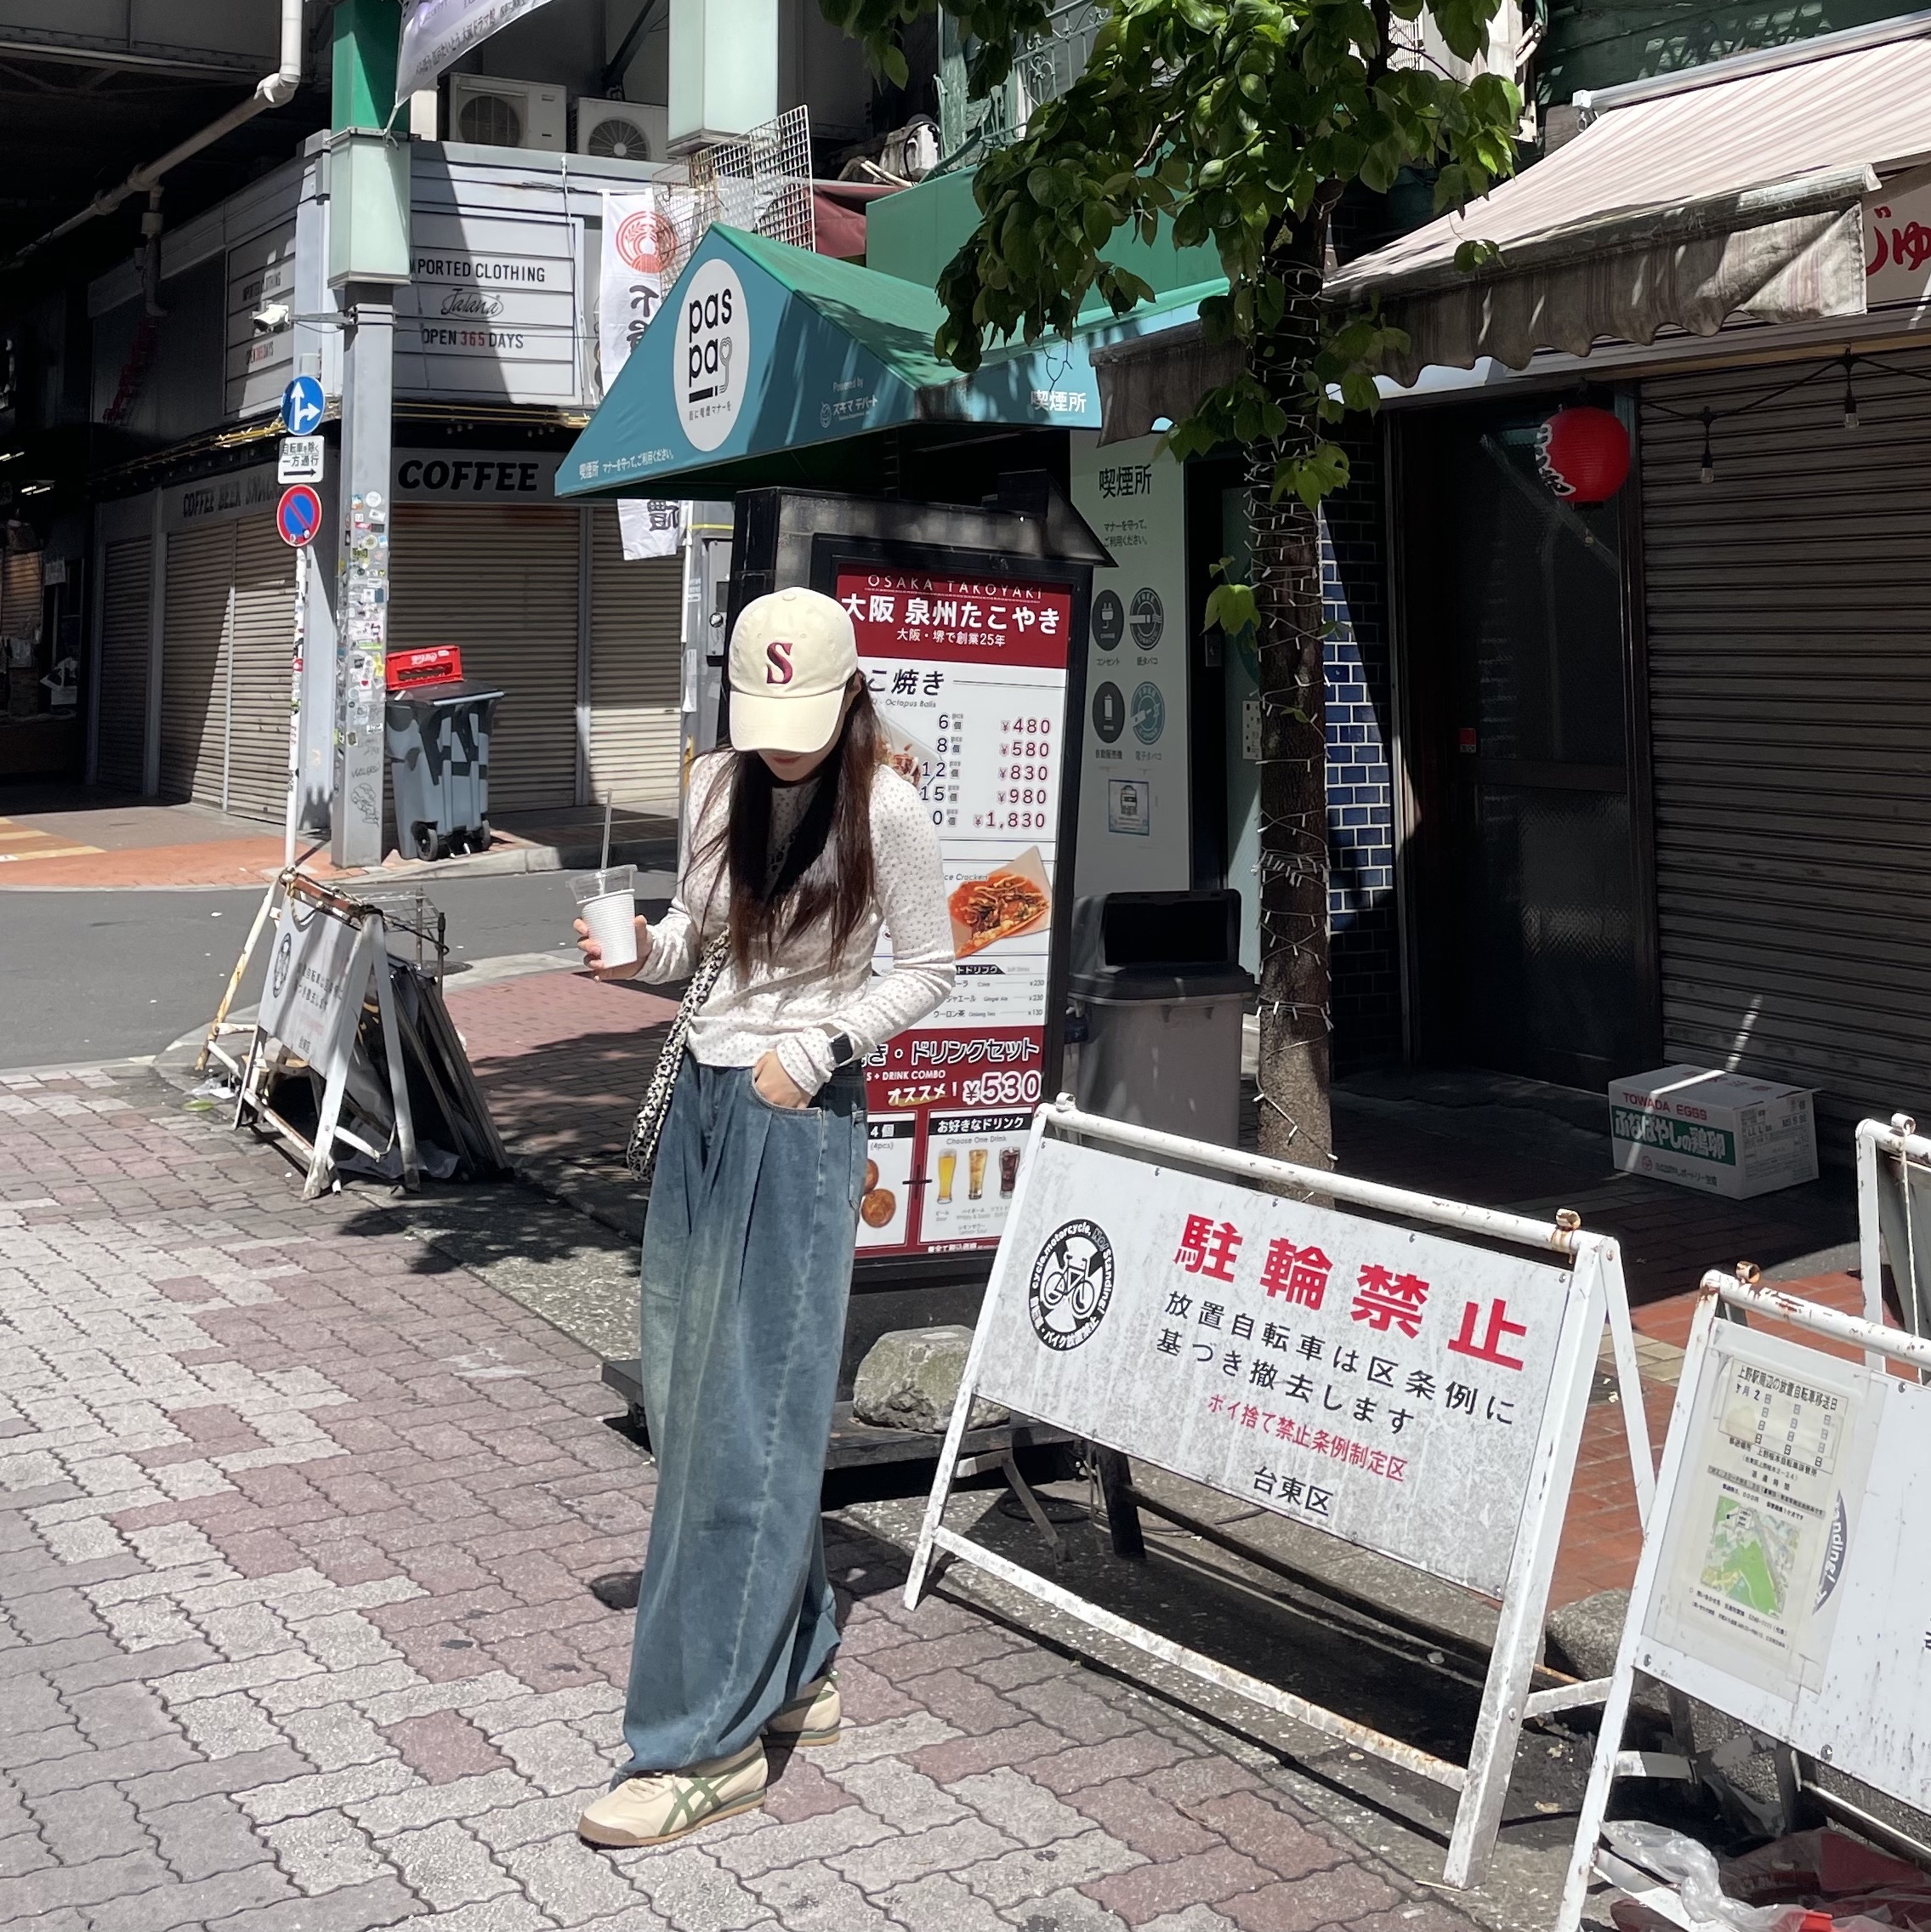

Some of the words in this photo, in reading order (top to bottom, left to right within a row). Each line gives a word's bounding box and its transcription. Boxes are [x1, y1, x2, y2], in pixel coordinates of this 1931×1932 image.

[414, 259, 471, 277] PORTED
[475, 263, 545, 283] CLOTHING
[689, 288, 732, 343] pas
[422, 328, 457, 346] OPEN
[460, 331, 486, 347] 365
[489, 332, 524, 349] DAYS
[1031, 389, 1087, 413] 喫煙所
[282, 456, 319, 467] 一方通行
[398, 459, 539, 492] COFFEE
[1099, 464, 1152, 499] 喫煙所
[1103, 519, 1147, 533] マナーを守って、
[867, 574, 934, 591] OSAKA
[947, 580, 1043, 600] TAKOYAKI
[841, 593, 895, 623] 大阪
[896, 628, 1006, 648] 大阪・堺で創業25年
[766, 641, 794, 685] S
[867, 668, 945, 696] こ焼き
[885, 698, 917, 707] Octopus
[939, 713, 949, 730] 6
[1002, 718, 1051, 735] ¥480
[936, 737, 948, 753] 8
[1000, 741, 1050, 757] ¥580
[922, 762, 946, 778] 12
[998, 764, 1048, 781] ¥830
[920, 786, 946, 801] 15
[997, 788, 1047, 804] ¥980
[932, 810, 943, 826] 0
[974, 811, 1046, 829] ¥1,830
[956, 965, 997, 975] トドリンク
[882, 1071, 909, 1081] DRINK
[911, 1069, 946, 1080] COMBO
[963, 1070, 1042, 1105] ¥530
[1622, 1092, 1671, 1113] TOWADA
[937, 1117, 1025, 1134] お好きなドリンク
[1097, 1248, 1112, 1315] Standing!
[1173, 1213, 1528, 1372] 駐輪禁止
[1165, 1290, 1516, 1426] 放置自転車は区条例に
[1156, 1327, 1415, 1435] 基づき撤去します
[1207, 1394, 1409, 1482] ポイ捨て禁止条例制定区
[1252, 1466, 1335, 1516] 台東区
[1826, 1520, 1843, 1583] nding!
